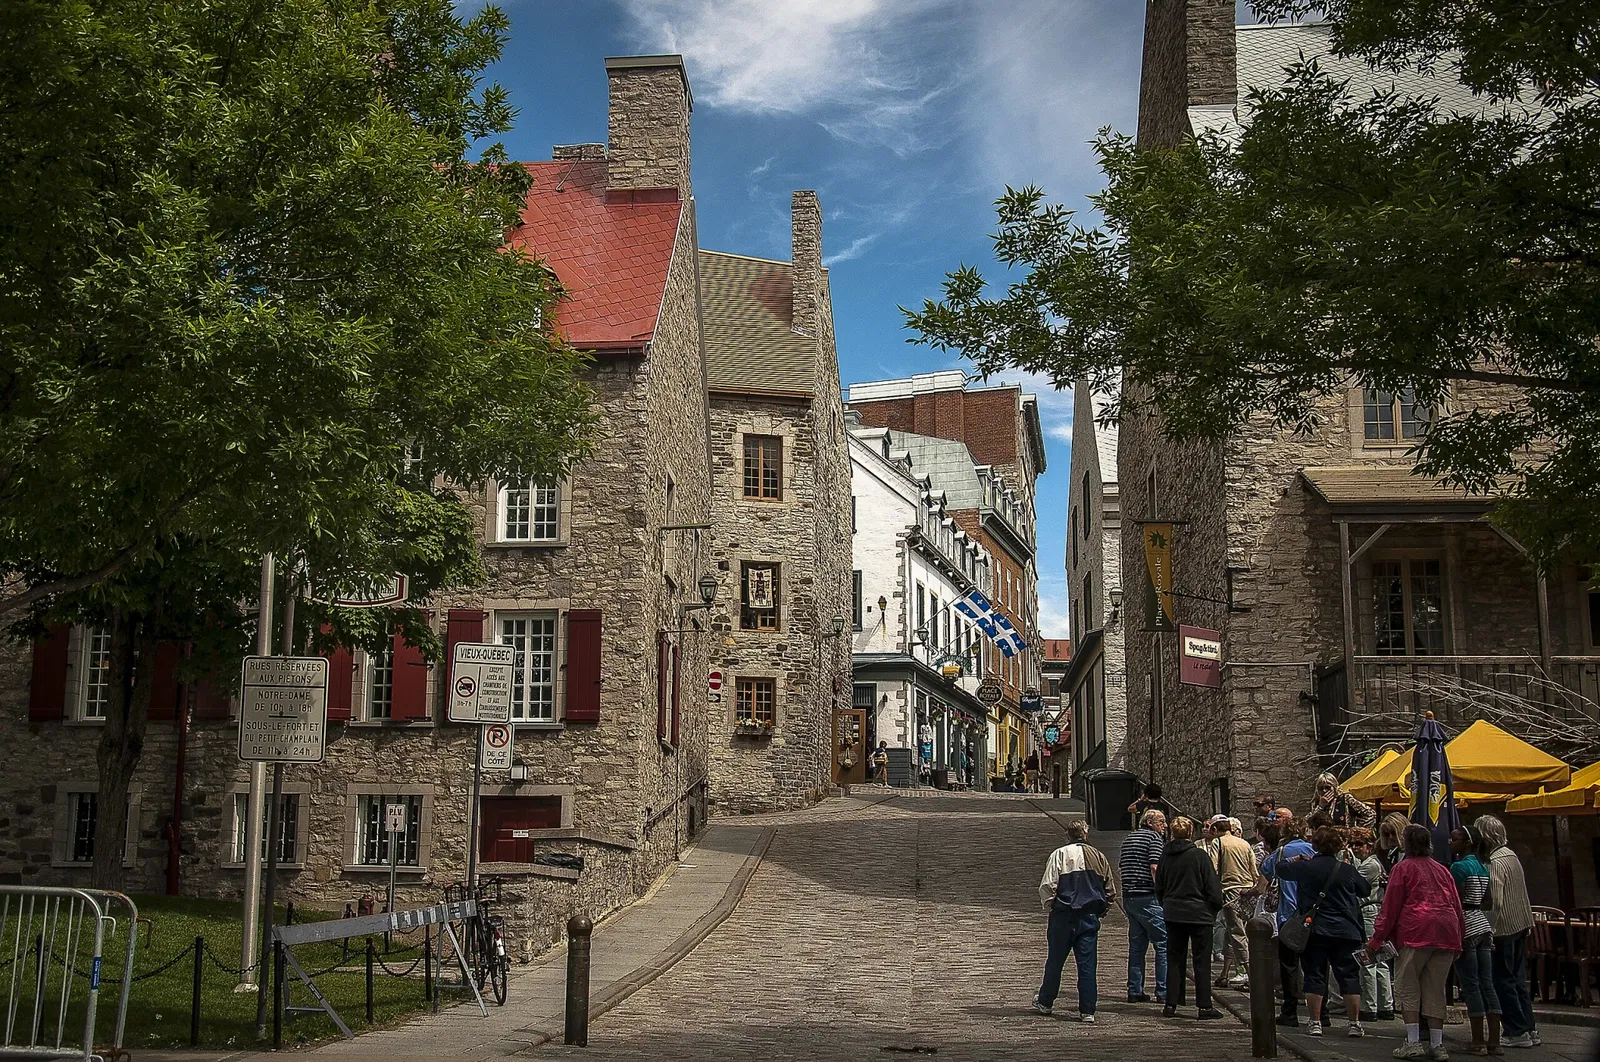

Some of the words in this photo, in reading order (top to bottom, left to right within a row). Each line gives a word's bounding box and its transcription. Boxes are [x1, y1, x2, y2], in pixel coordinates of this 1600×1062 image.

[461, 648, 510, 660] VIEUX-QUÉBEC
[250, 662, 270, 670] RUES
[276, 662, 321, 671] RÉSERVÉES
[278, 672, 312, 683] PIÉTONS
[258, 691, 310, 700] NOTRE-DAME
[255, 703, 265, 711] DE
[299, 704, 312, 712] 18h
[246, 722, 306, 730] SOUS-LE-FORT
[259, 734, 318, 743] PETIT-CHAMPLAIN
[284, 747, 287, 755] à
